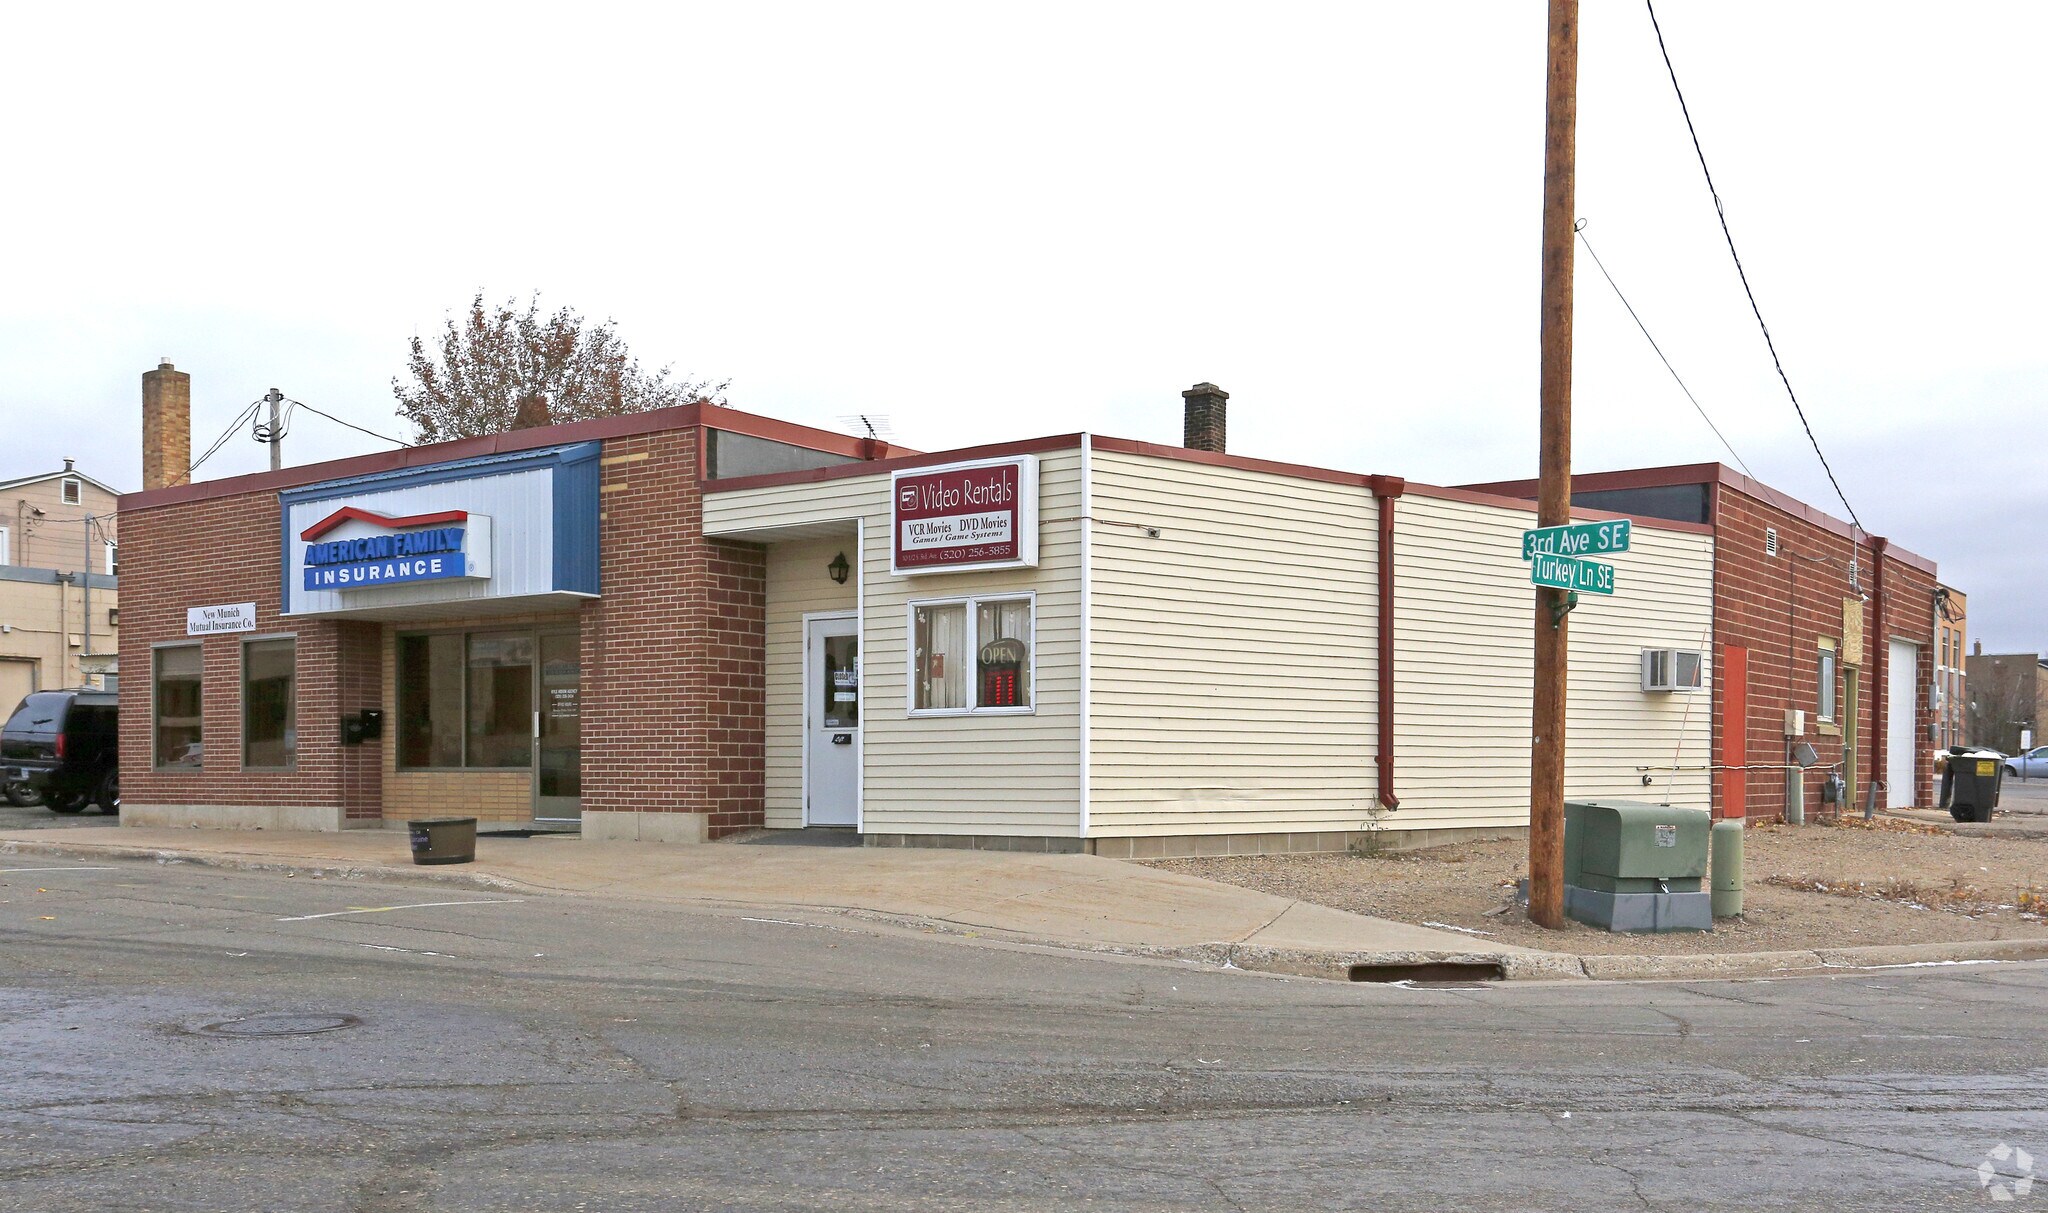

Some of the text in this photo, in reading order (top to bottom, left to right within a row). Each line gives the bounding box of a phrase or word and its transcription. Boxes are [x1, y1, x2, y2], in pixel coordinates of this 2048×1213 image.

[922, 470, 1012, 512] Video Rentals
[908, 516, 1008, 536] VCR Movies DVD Movies
[304, 528, 465, 566] AMERICAN FAMILY
[912, 535, 938, 544] Games
[945, 533, 969, 541] Game
[971, 531, 1003, 540] Systems
[1526, 524, 1624, 557] 3rd Ave SE
[939, 549, 966, 560] (320)
[968, 545, 1011, 558] 256-3855
[315, 559, 442, 585] INSURANCE
[1536, 554, 1612, 589] Turkey Ln SE
[203, 607, 240, 620] New Munich
[190, 618, 254, 632] Mutual Insurance Co.
[981, 647, 1017, 665] OPEN
